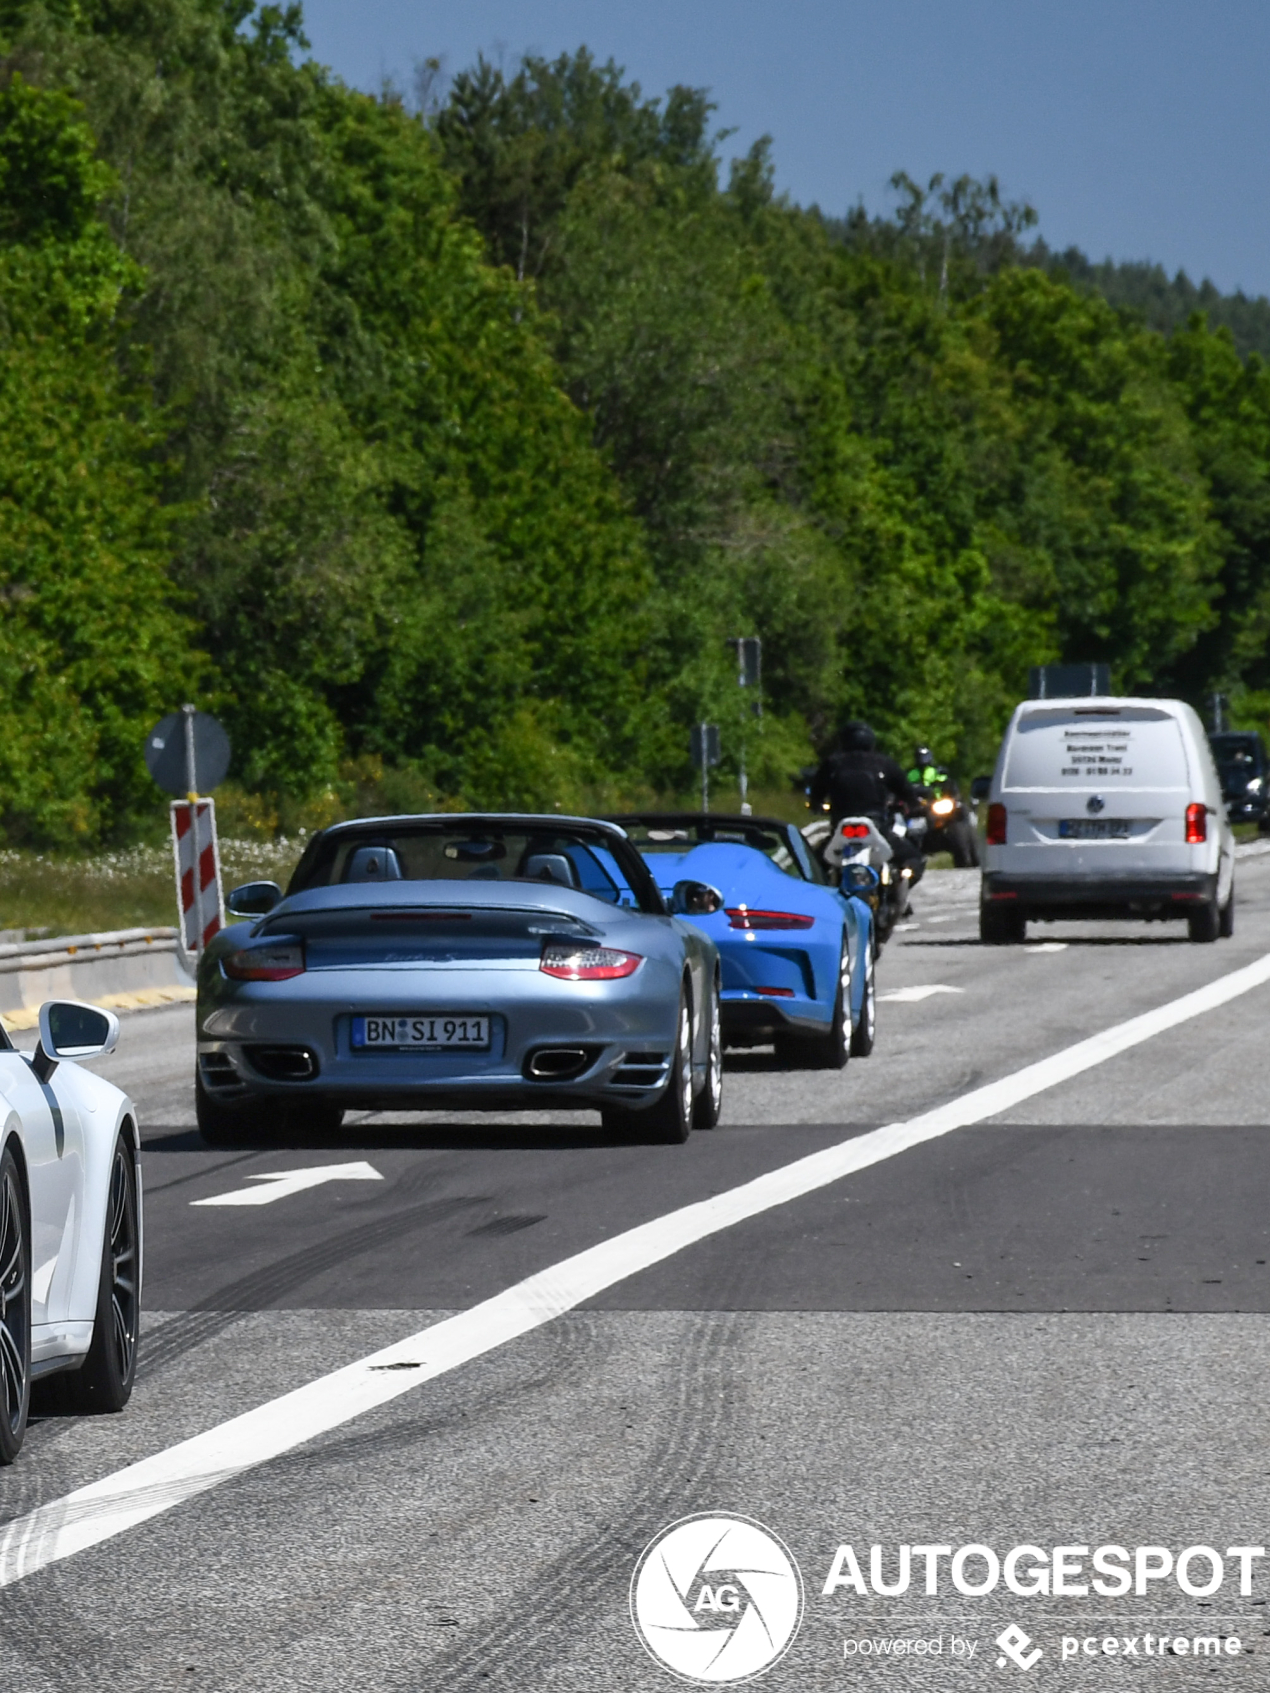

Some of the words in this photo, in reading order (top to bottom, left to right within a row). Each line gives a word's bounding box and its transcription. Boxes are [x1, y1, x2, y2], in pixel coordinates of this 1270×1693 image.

[367, 1020, 396, 1041] BN
[411, 1020, 437, 1041] SI
[443, 1020, 484, 1041] 911
